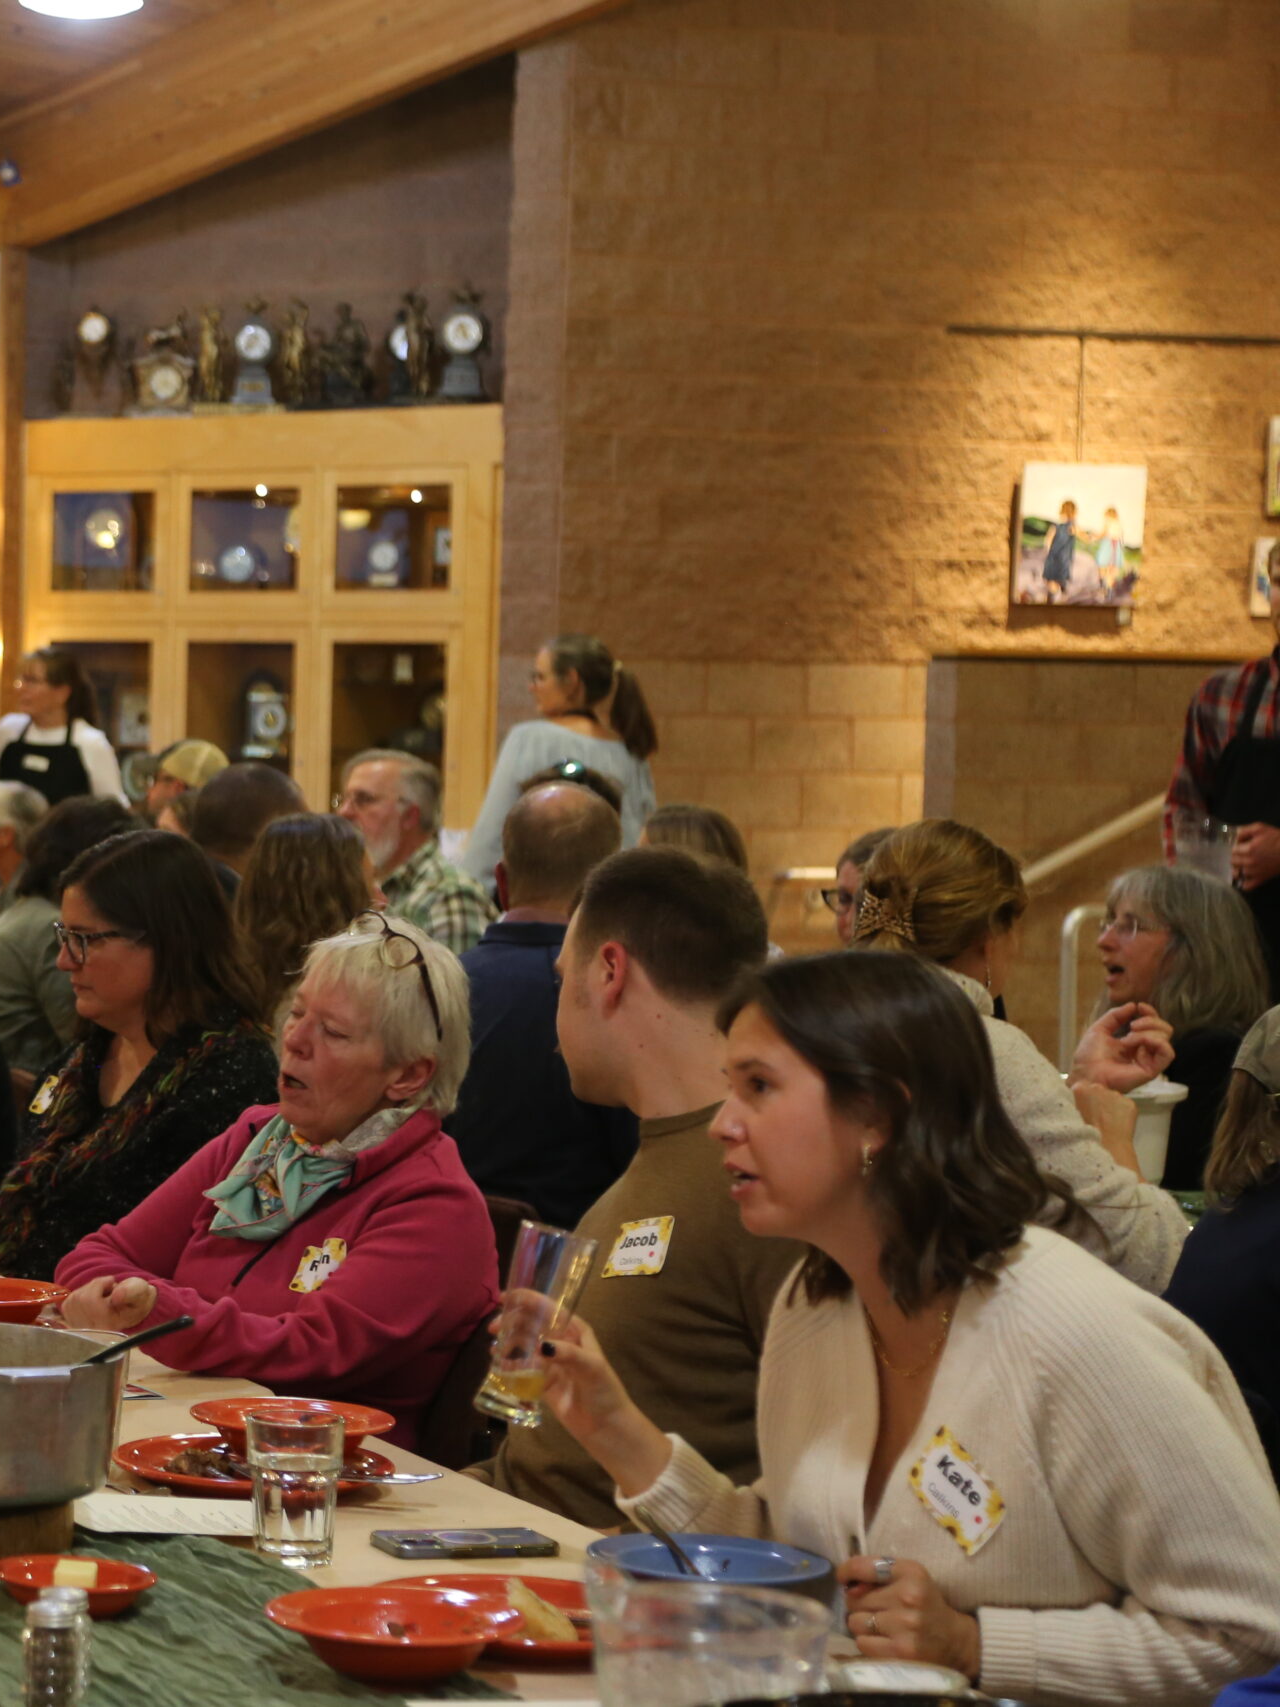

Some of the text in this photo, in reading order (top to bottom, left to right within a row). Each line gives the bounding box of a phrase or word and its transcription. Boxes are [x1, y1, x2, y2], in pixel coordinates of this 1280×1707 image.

[619, 1232, 658, 1250] Jacob
[936, 1454, 982, 1506] Kate
[927, 1482, 960, 1519] Calkins
